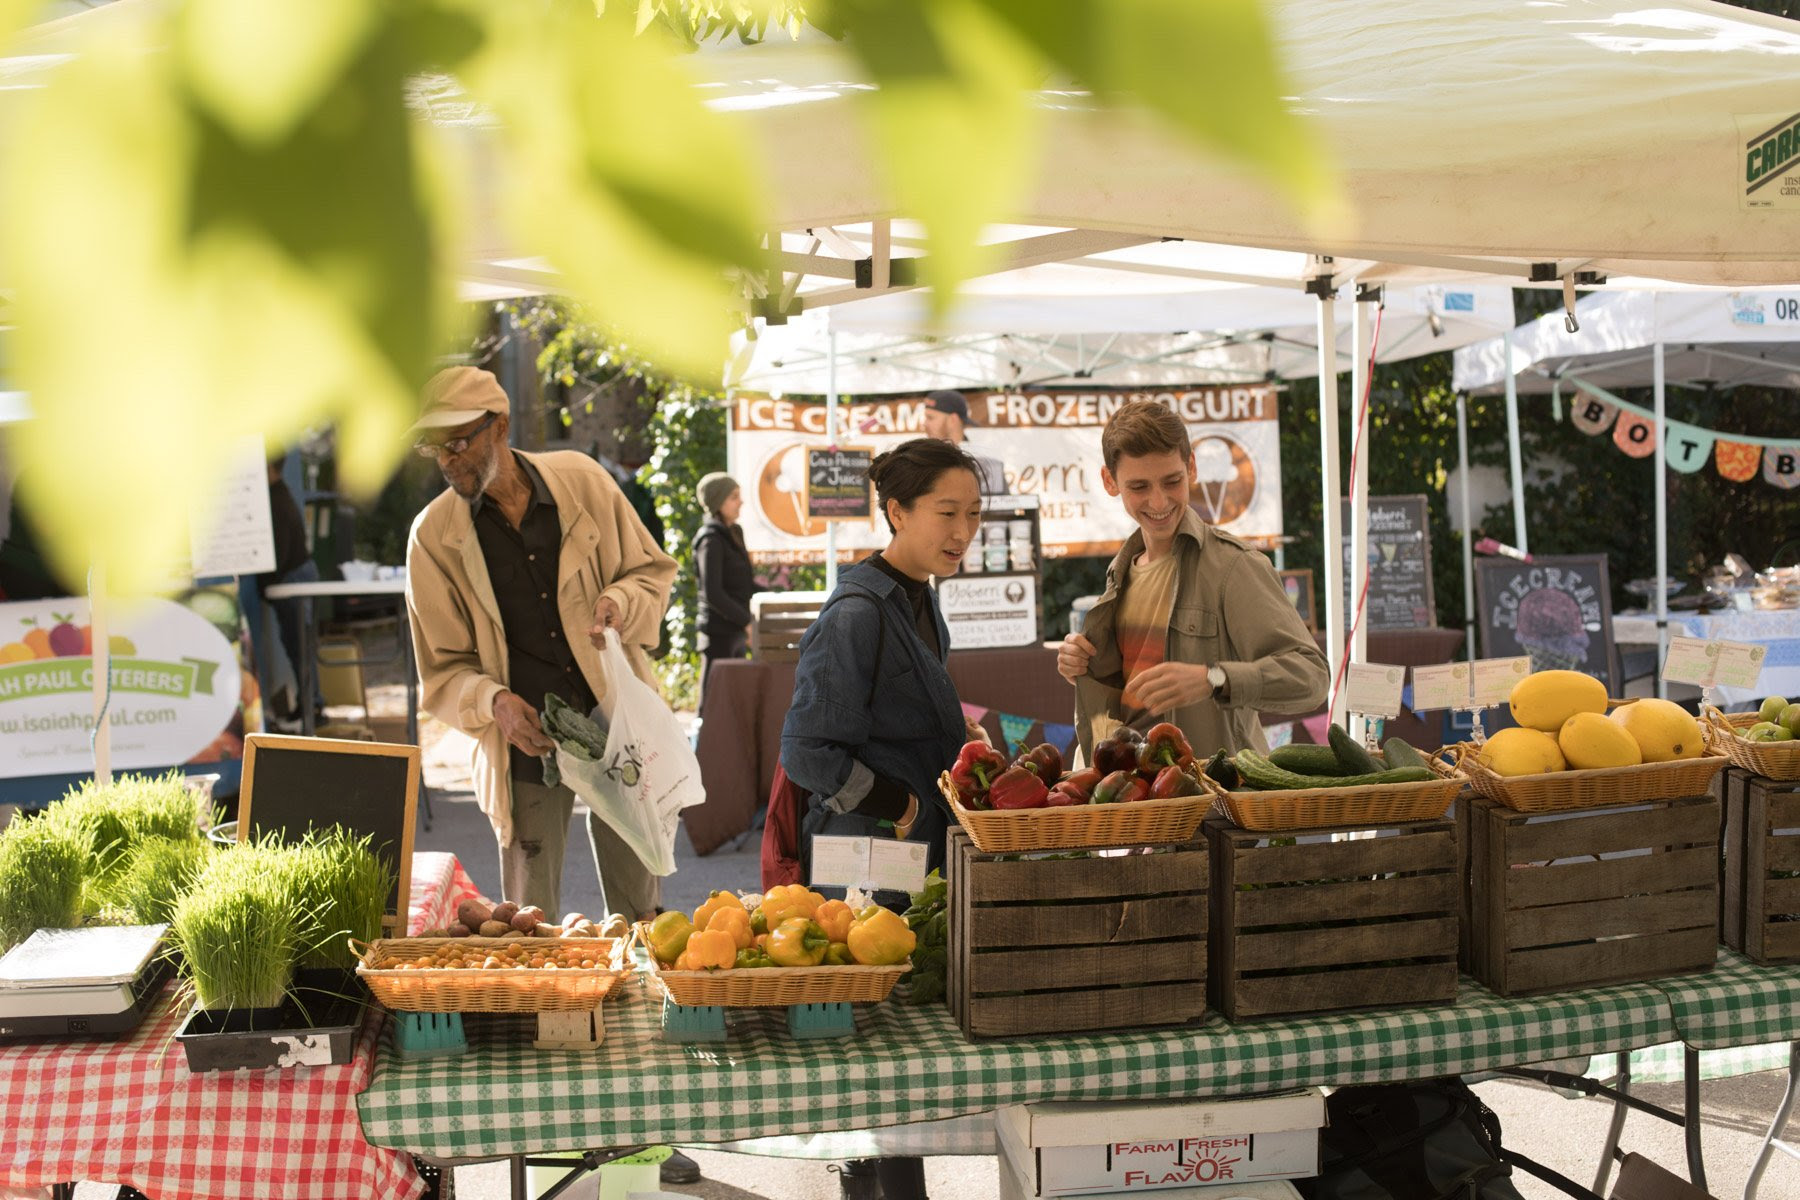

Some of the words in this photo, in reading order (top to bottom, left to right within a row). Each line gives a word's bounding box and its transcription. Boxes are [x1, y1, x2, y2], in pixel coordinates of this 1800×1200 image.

[738, 397, 796, 430] ICE
[800, 402, 927, 433] CREAM
[986, 393, 1123, 426] FROZEN
[24, 673, 77, 692] PAUL
[82, 669, 185, 693] CTERERS
[0, 707, 177, 737] w.isaiahpul.com
[1115, 1142, 1175, 1155] FARM
[1184, 1137, 1248, 1151] FRESH
[1125, 1158, 1234, 1187] FLAVOR
